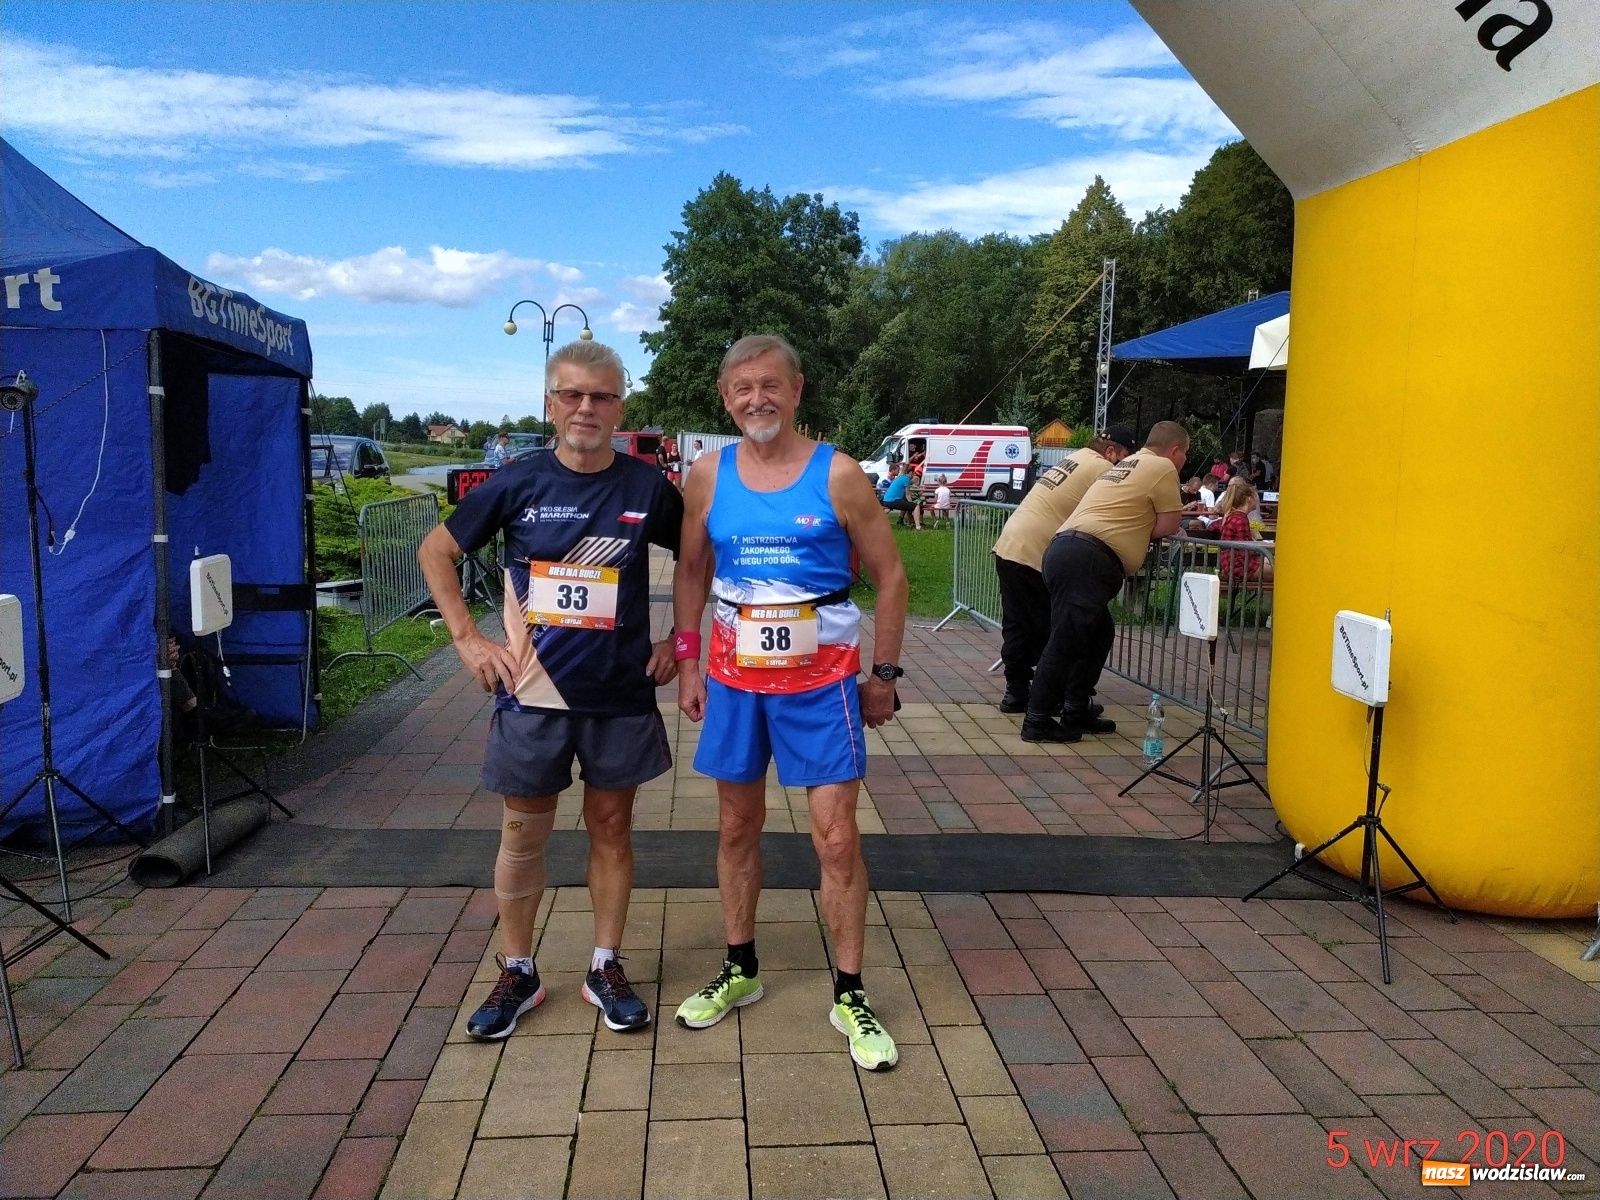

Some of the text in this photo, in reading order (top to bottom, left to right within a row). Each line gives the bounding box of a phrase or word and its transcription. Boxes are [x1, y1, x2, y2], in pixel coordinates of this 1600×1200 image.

[187, 274, 295, 356] BGTimeSport
[731, 535, 798, 545] 7. MISTRZOSTWA
[740, 546, 790, 555] ZAKOPANEGO
[741, 557, 762, 565] BIEGU
[763, 556, 779, 565] POD
[780, 554, 801, 566] GÓRĘ
[548, 566, 602, 579] BIEG NA BUCZE
[557, 584, 589, 611] 33
[751, 608, 801, 619] BIEG NA BUCZE
[760, 626, 791, 652] 38
[1339, 624, 1369, 691] BGTimeSport.pl
